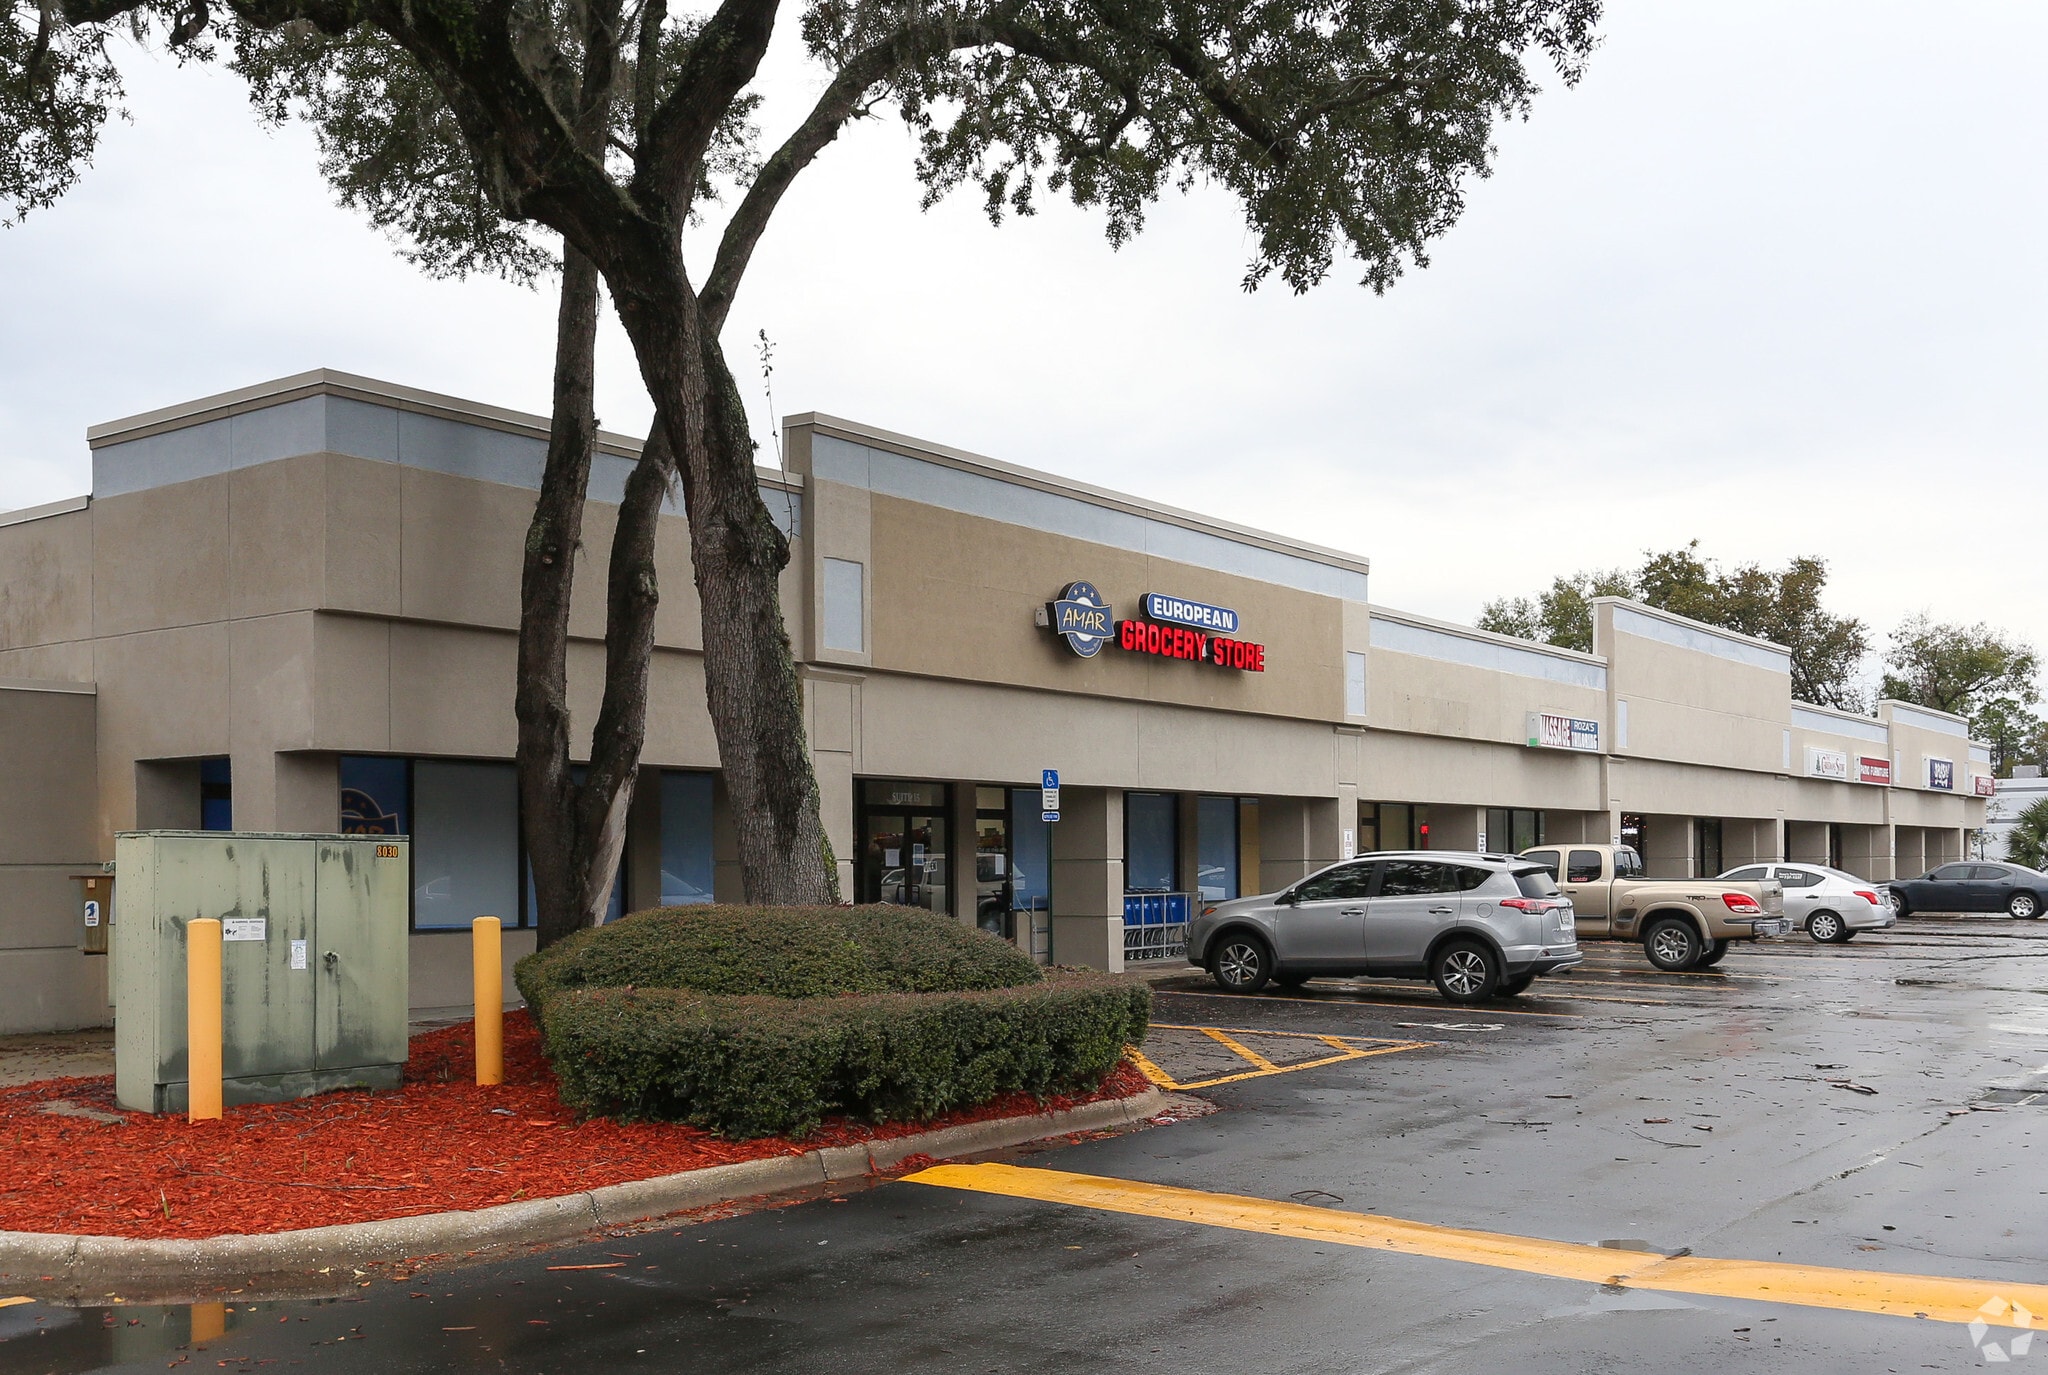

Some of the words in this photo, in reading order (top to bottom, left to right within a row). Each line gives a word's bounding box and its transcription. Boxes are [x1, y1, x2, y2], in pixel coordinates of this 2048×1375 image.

[1062, 607, 1107, 632] AMAR
[1153, 597, 1233, 630] EUROPEAN
[1121, 619, 1207, 662] GROCERY
[1213, 637, 1265, 672] STORE
[1540, 714, 1570, 748] MASSAGE
[1573, 720, 1596, 732] ROZA'S
[377, 845, 398, 857] 8030
